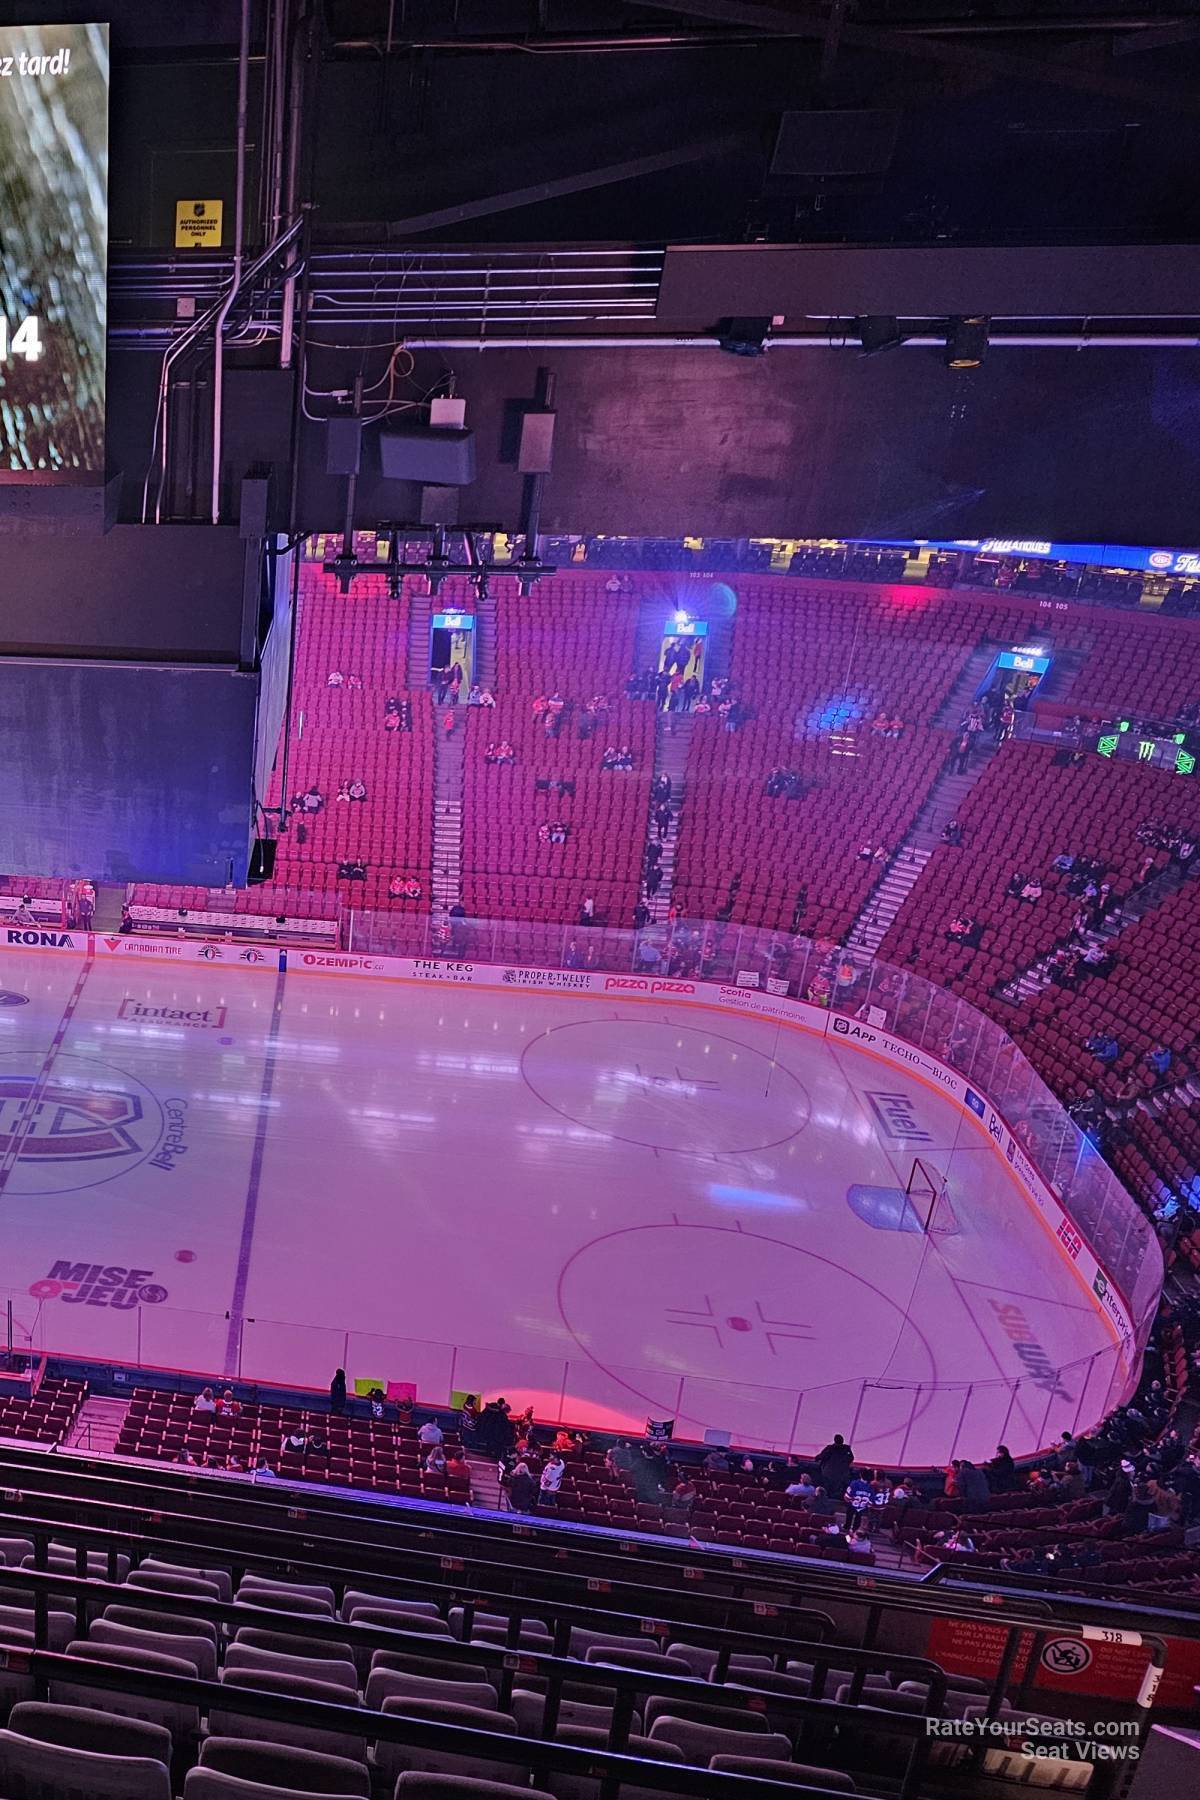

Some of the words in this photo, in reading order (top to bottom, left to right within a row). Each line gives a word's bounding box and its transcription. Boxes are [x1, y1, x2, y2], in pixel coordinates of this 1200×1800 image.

[18, 49, 70, 77] tard!
[7, 930, 75, 948] RONA
[124, 943, 164, 954] CANADIAN
[164, 946, 182, 955] TIRE
[413, 960, 440, 970] THE
[446, 962, 473, 972] KEG
[412, 971, 443, 979] STEAK
[604, 977, 648, 990] pizza
[651, 981, 695, 994] pizza
[720, 986, 751, 999] Scotia
[719, 996, 749, 1007] Gestion
[133, 1003, 213, 1022] intact
[989, 1113, 1004, 1143] Bell
[47, 1260, 154, 1288] MISE
[1102, 1630, 1123, 1644] 318
